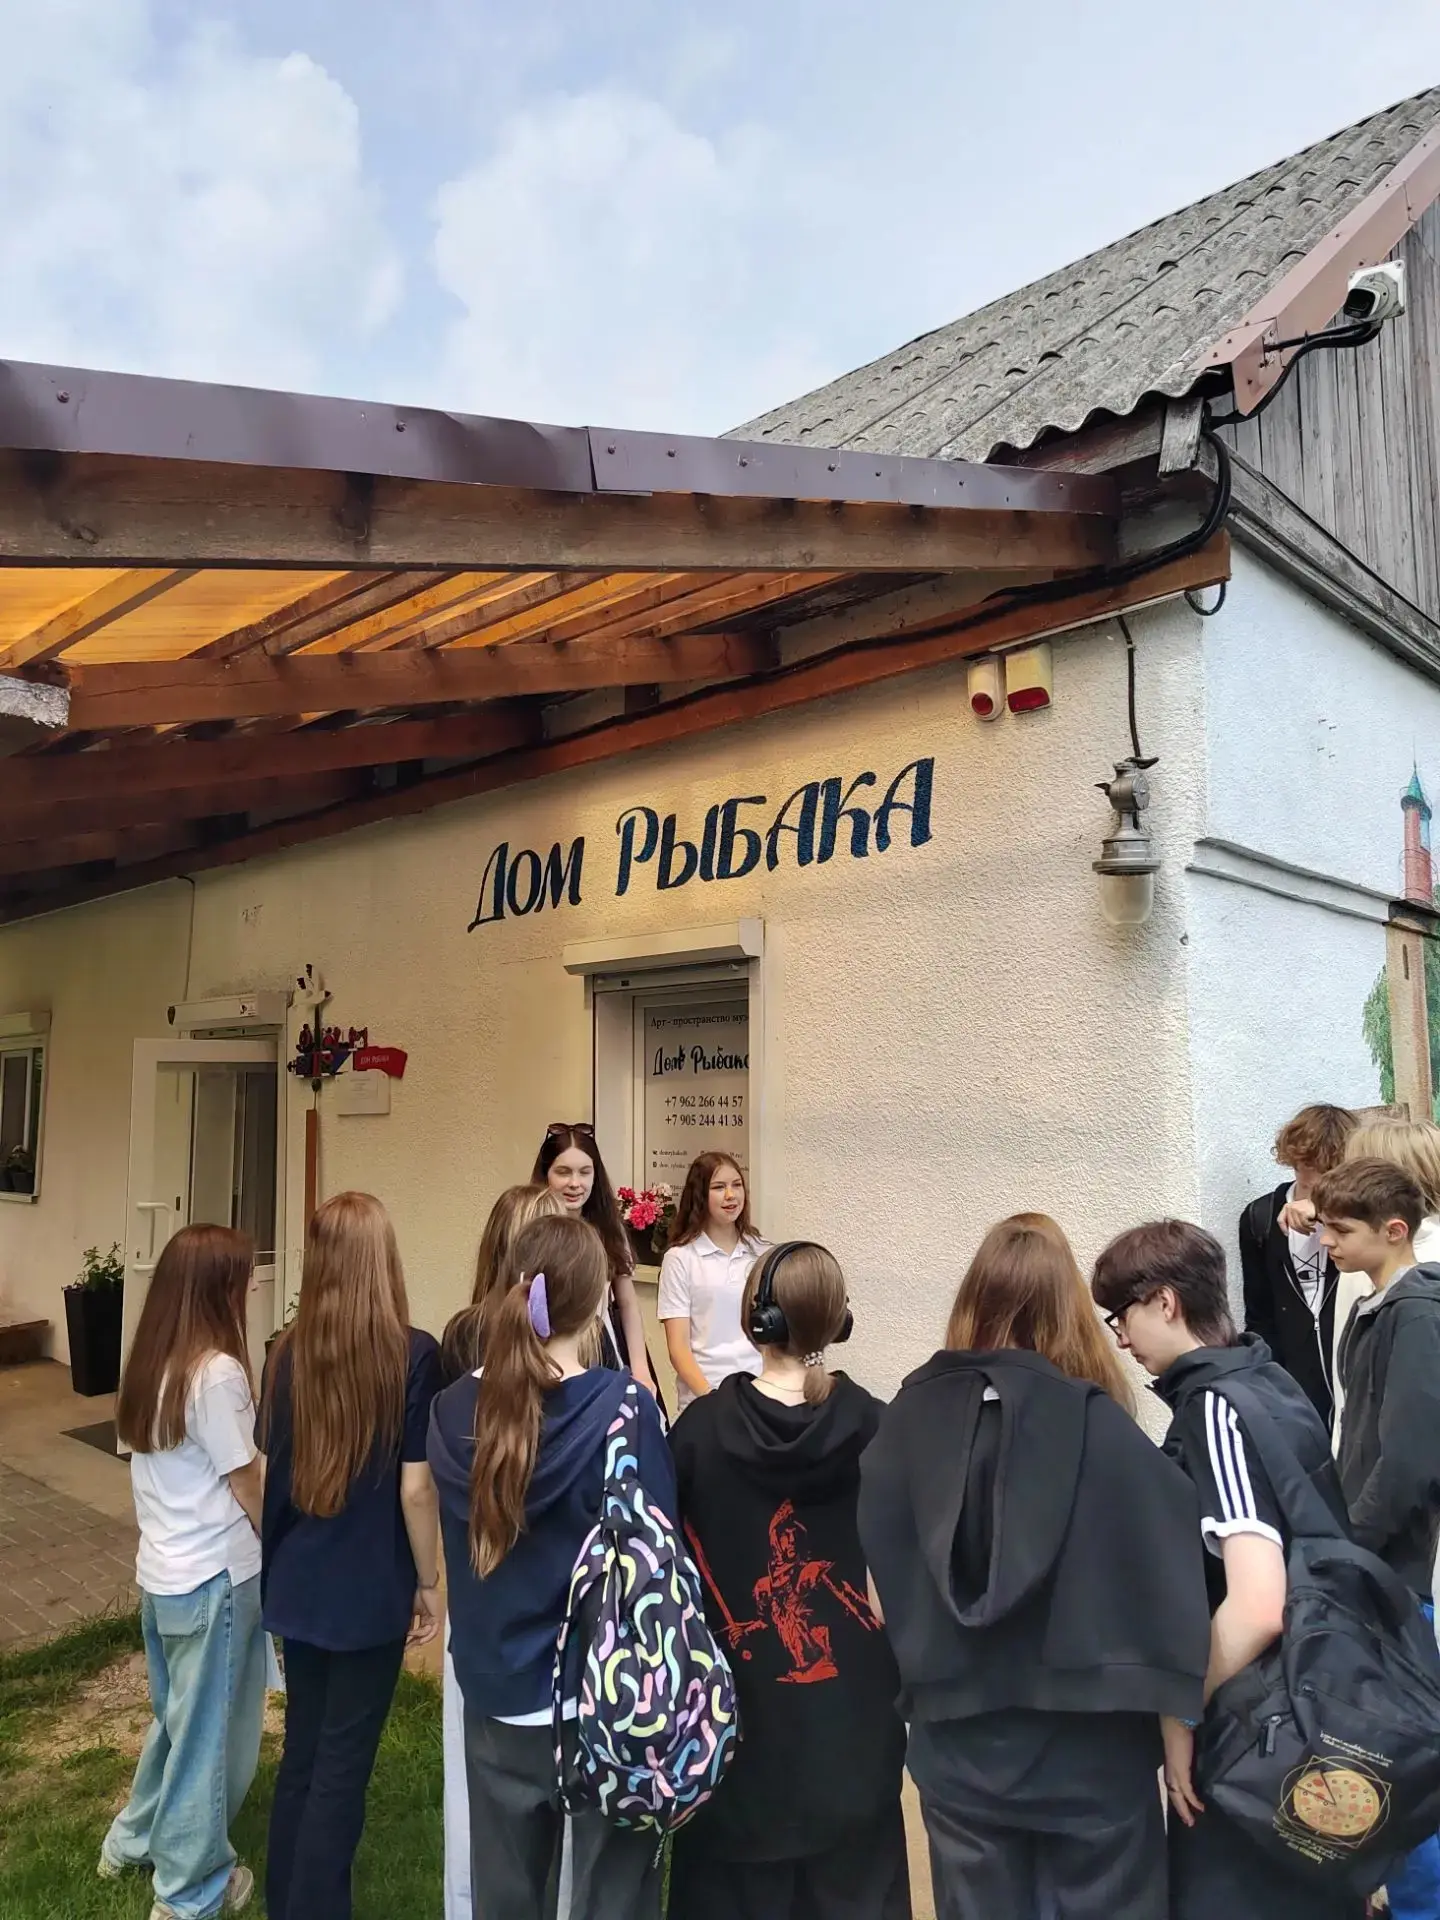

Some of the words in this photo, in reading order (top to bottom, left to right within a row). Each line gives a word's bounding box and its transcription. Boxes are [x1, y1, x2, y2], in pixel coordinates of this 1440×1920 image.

[468, 836, 585, 933] ДОМ
[614, 757, 936, 896] РЫБАКА
[672, 1014, 731, 1028] пространство
[653, 1044, 686, 1076] Дом
[665, 1096, 677, 1107] +7
[679, 1095, 696, 1108] 962
[698, 1095, 715, 1108] 266
[717, 1095, 729, 1108] 44
[731, 1095, 744, 1108] 57
[665, 1114, 677, 1126] +7
[680, 1114, 696, 1126] 905
[698, 1114, 715, 1126] 244
[717, 1114, 729, 1126] 41
[731, 1114, 744, 1127] 38
